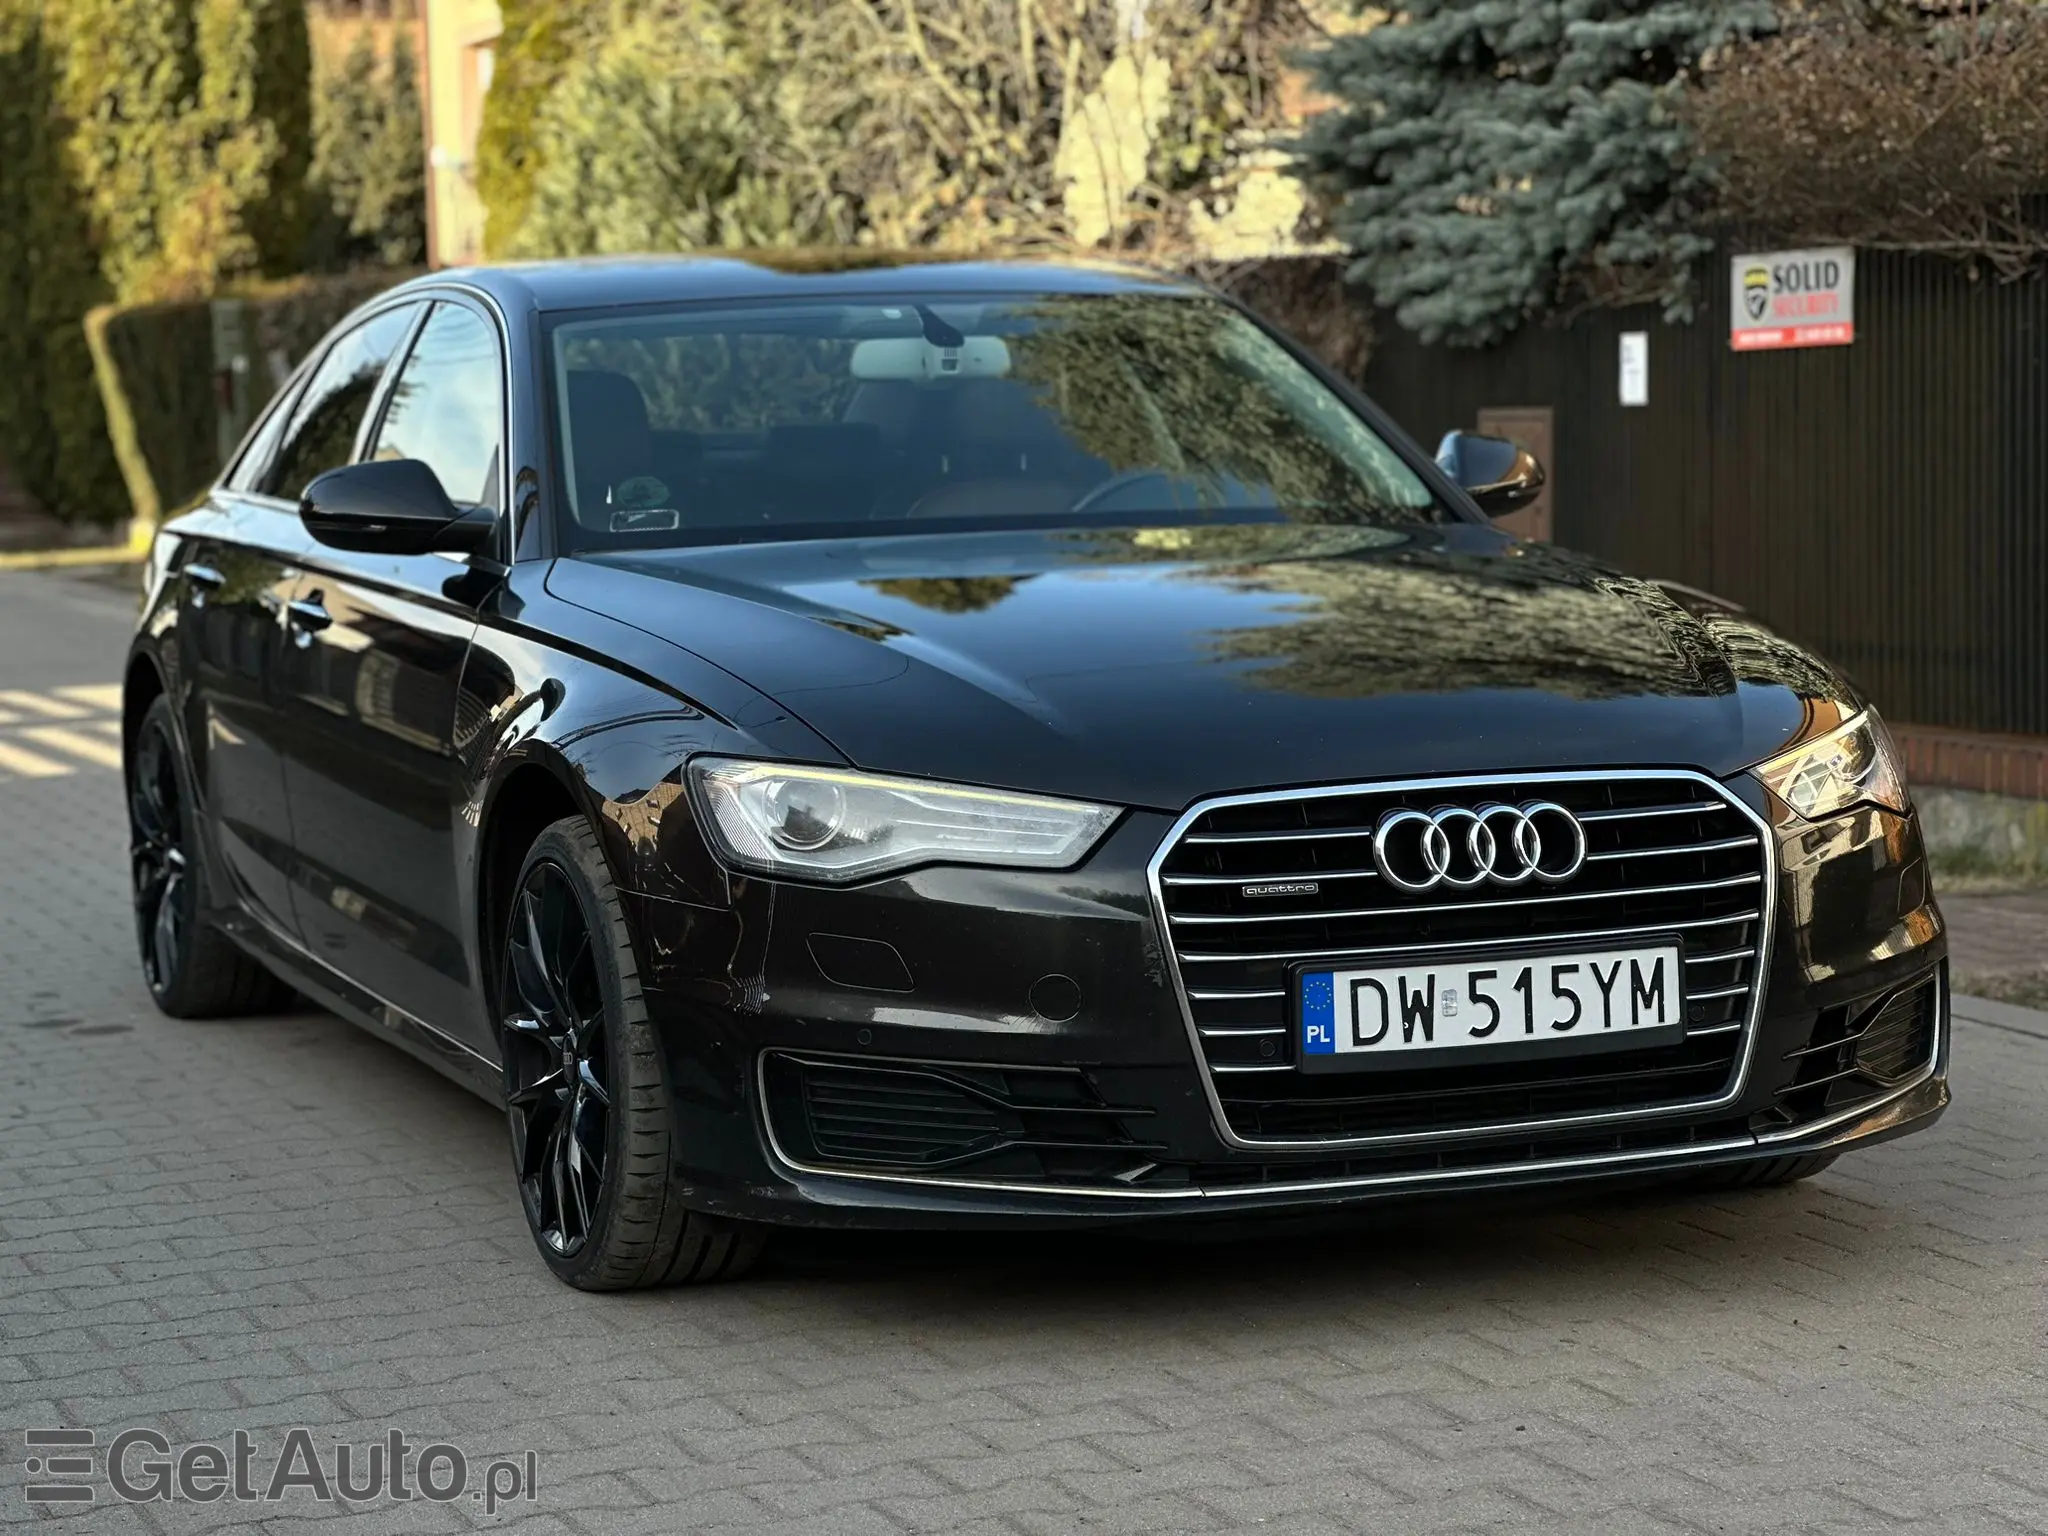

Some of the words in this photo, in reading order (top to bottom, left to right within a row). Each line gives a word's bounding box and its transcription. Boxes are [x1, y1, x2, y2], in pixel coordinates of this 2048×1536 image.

[1773, 260, 1839, 293] SOLID
[1246, 885, 1315, 896] quattro
[1350, 974, 1436, 1046] DW
[1467, 957, 1666, 1038] 515YM
[1306, 1026, 1331, 1044] PL
